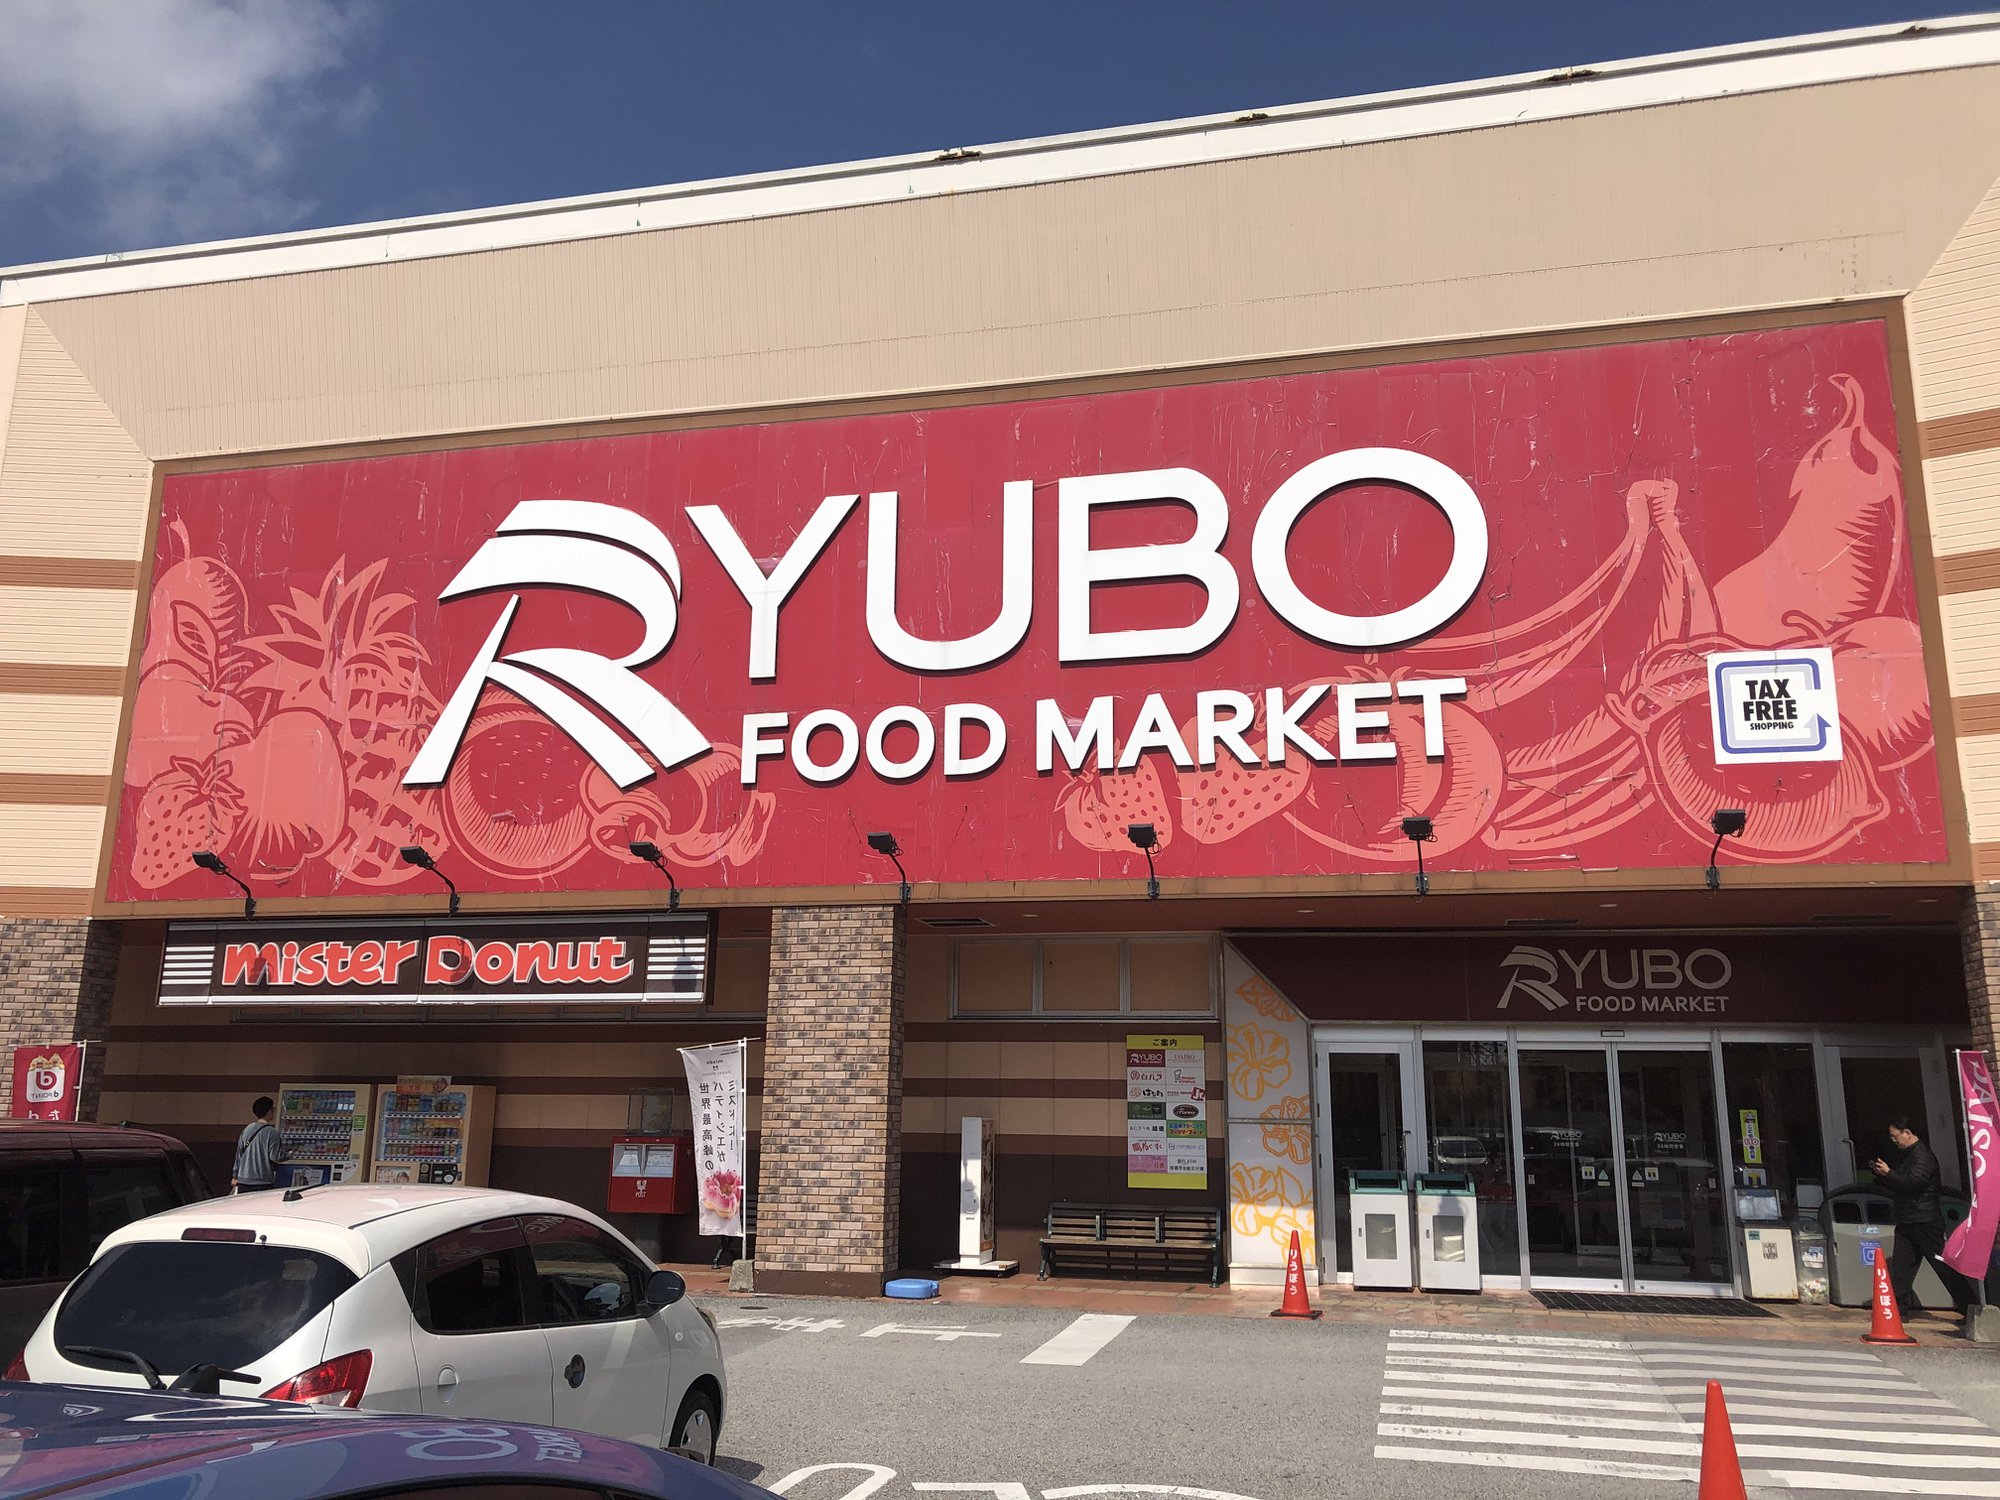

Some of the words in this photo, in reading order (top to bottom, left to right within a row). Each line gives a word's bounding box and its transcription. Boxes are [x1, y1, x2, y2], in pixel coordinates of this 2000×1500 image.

[403, 446, 1489, 790] RYUBO
[1745, 678, 1791, 700] TAX
[1743, 699, 1798, 721] FREE
[741, 703, 1007, 785] FOOD
[1035, 676, 1469, 773] MARKET
[1750, 721, 1794, 731] SHOPPING
[424, 934, 635, 986] Donut
[1496, 945, 1733, 1011] RYUBO
[1576, 996, 1636, 1012] FOOD
[1641, 996, 1730, 1012] MARKET
[1152, 1038, 1178, 1047] ご案内
[1130, 1053, 1163, 1064] RYUBO
[1653, 1132, 1687, 1142] RYUBO
[1289, 1248, 1298, 1296] りうぼう
[1877, 1268, 1893, 1320] りうぼう
